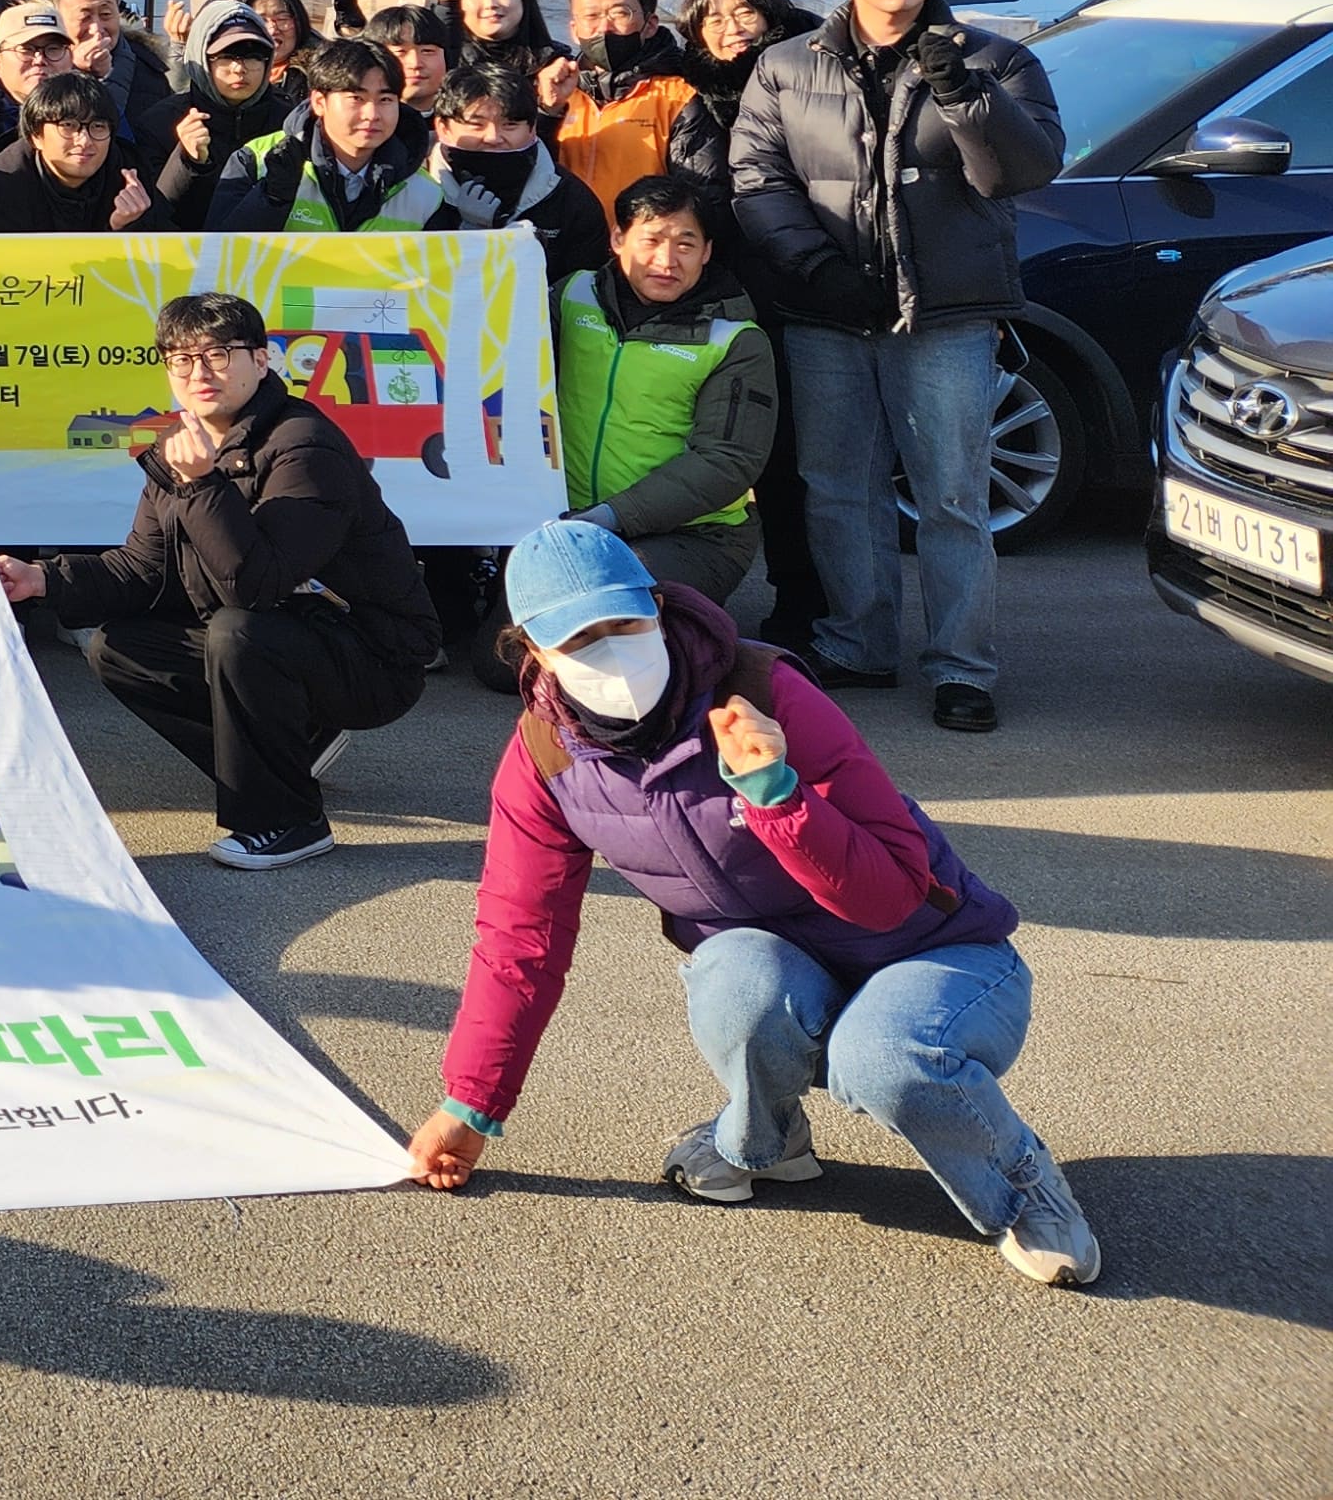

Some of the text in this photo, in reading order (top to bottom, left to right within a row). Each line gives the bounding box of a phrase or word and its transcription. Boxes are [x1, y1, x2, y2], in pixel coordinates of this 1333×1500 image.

[17, 343, 90, 368] 7일(토)
[97, 345, 163, 366] 09:30
[1179, 493, 1299, 571] 21버 0131
